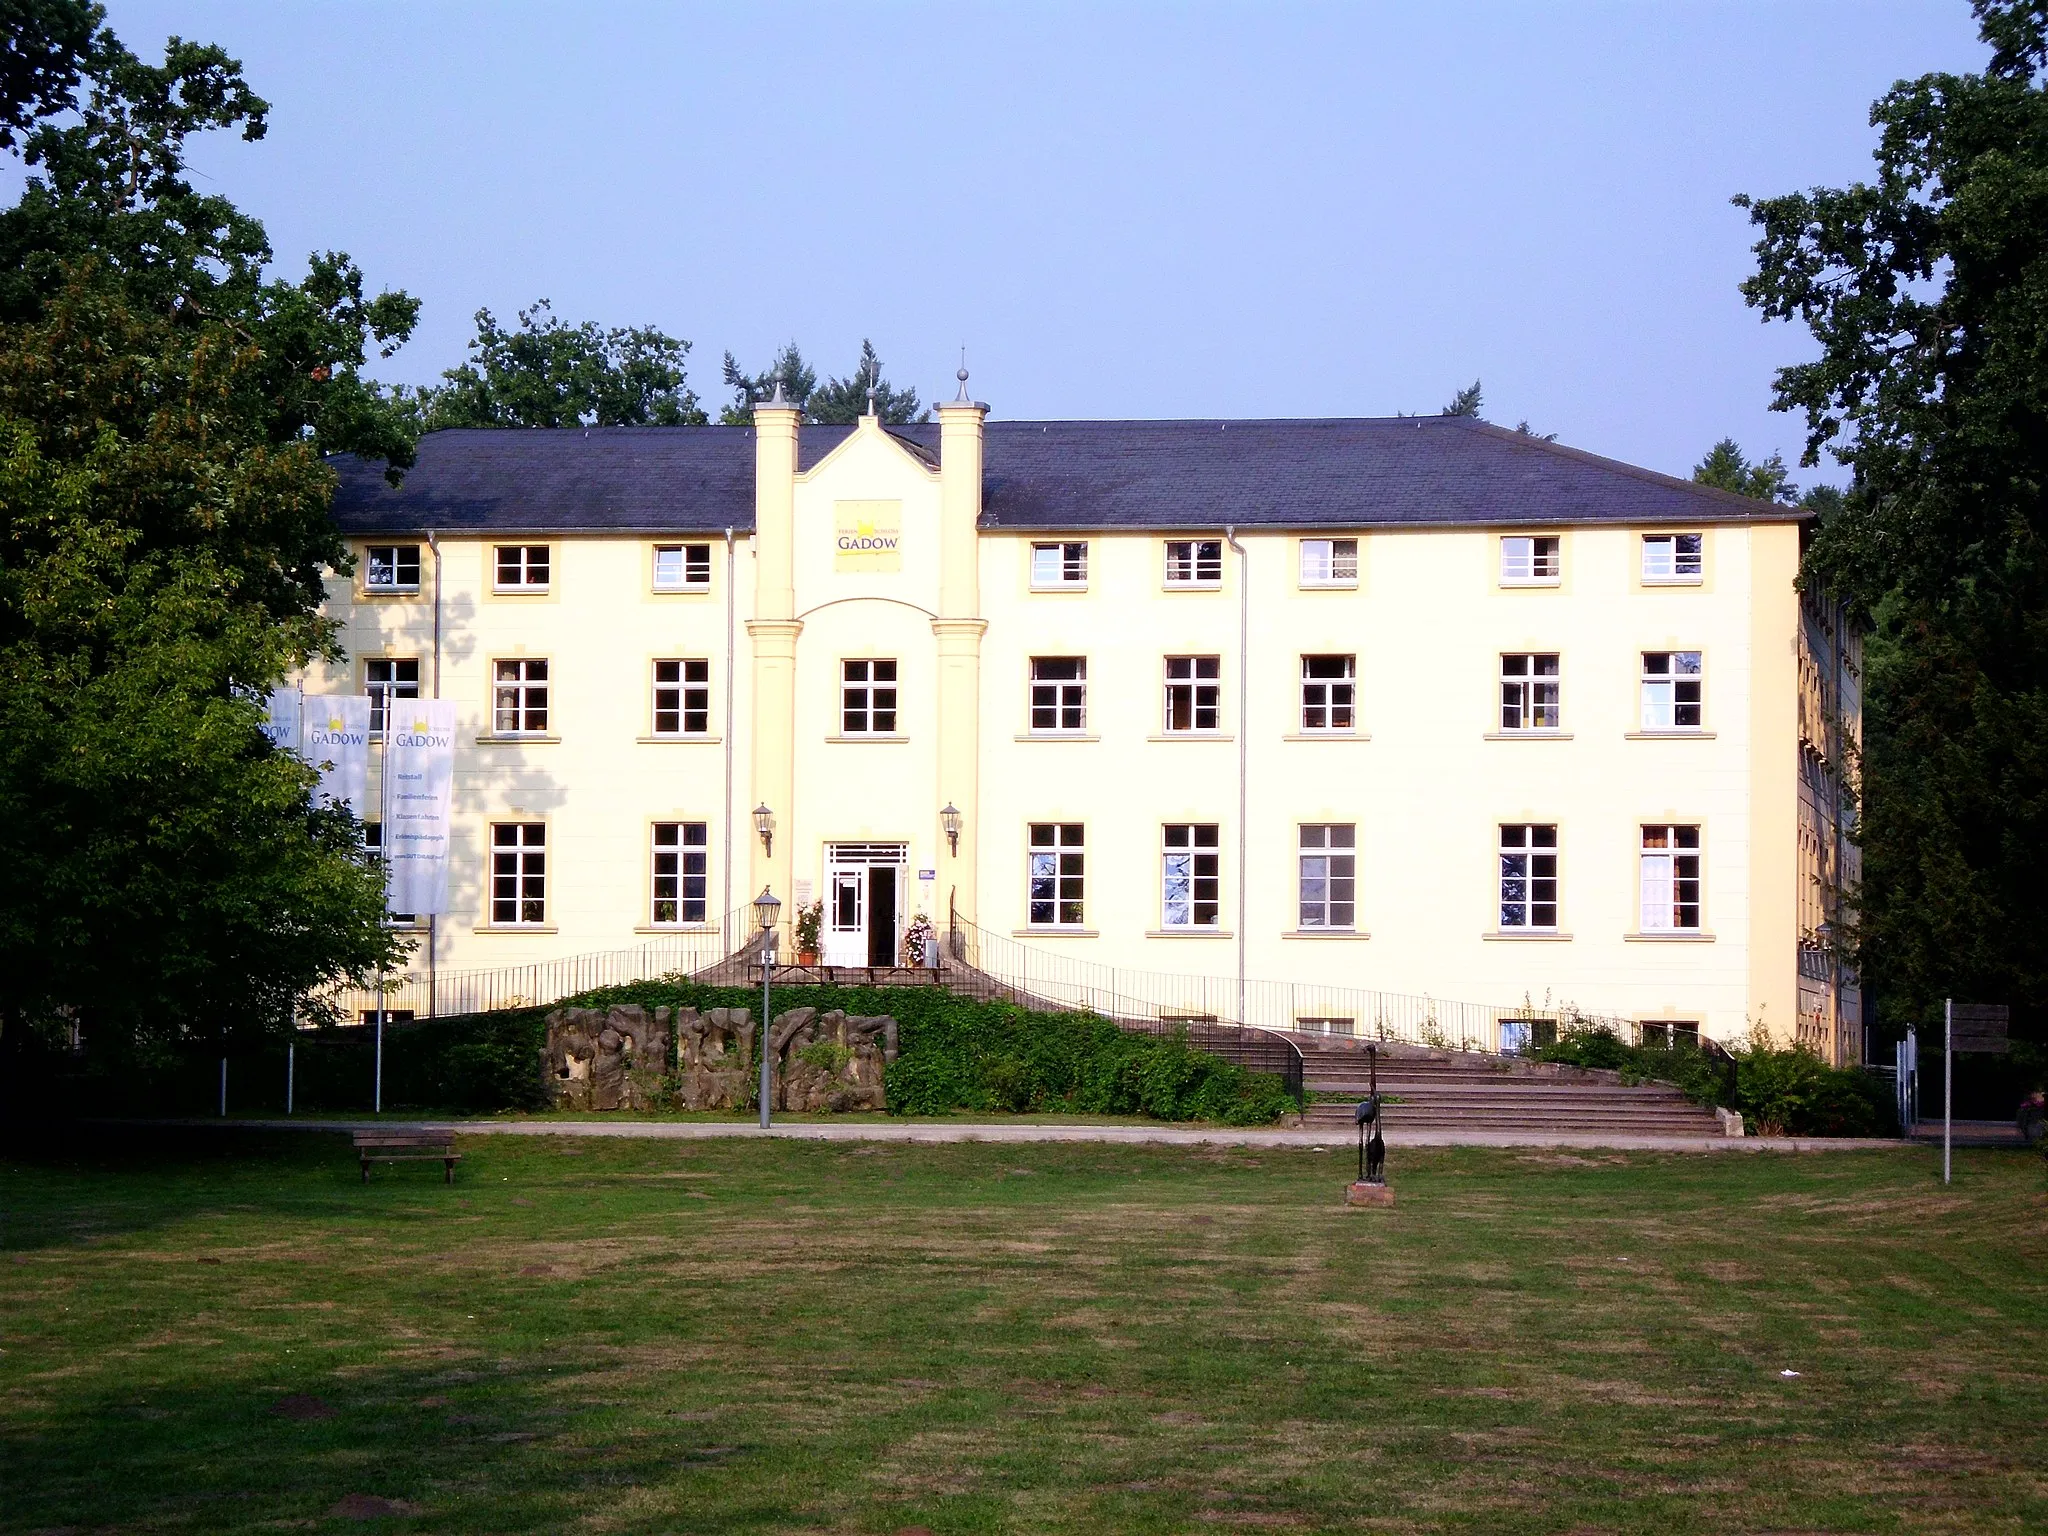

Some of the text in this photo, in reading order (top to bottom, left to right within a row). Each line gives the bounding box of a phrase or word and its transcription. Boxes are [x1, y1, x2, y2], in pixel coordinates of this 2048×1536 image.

[838, 537, 898, 549] GADOW
[261, 726, 290, 738] DOW
[312, 731, 364, 745] GADOW
[396, 734, 450, 747] GADOW
